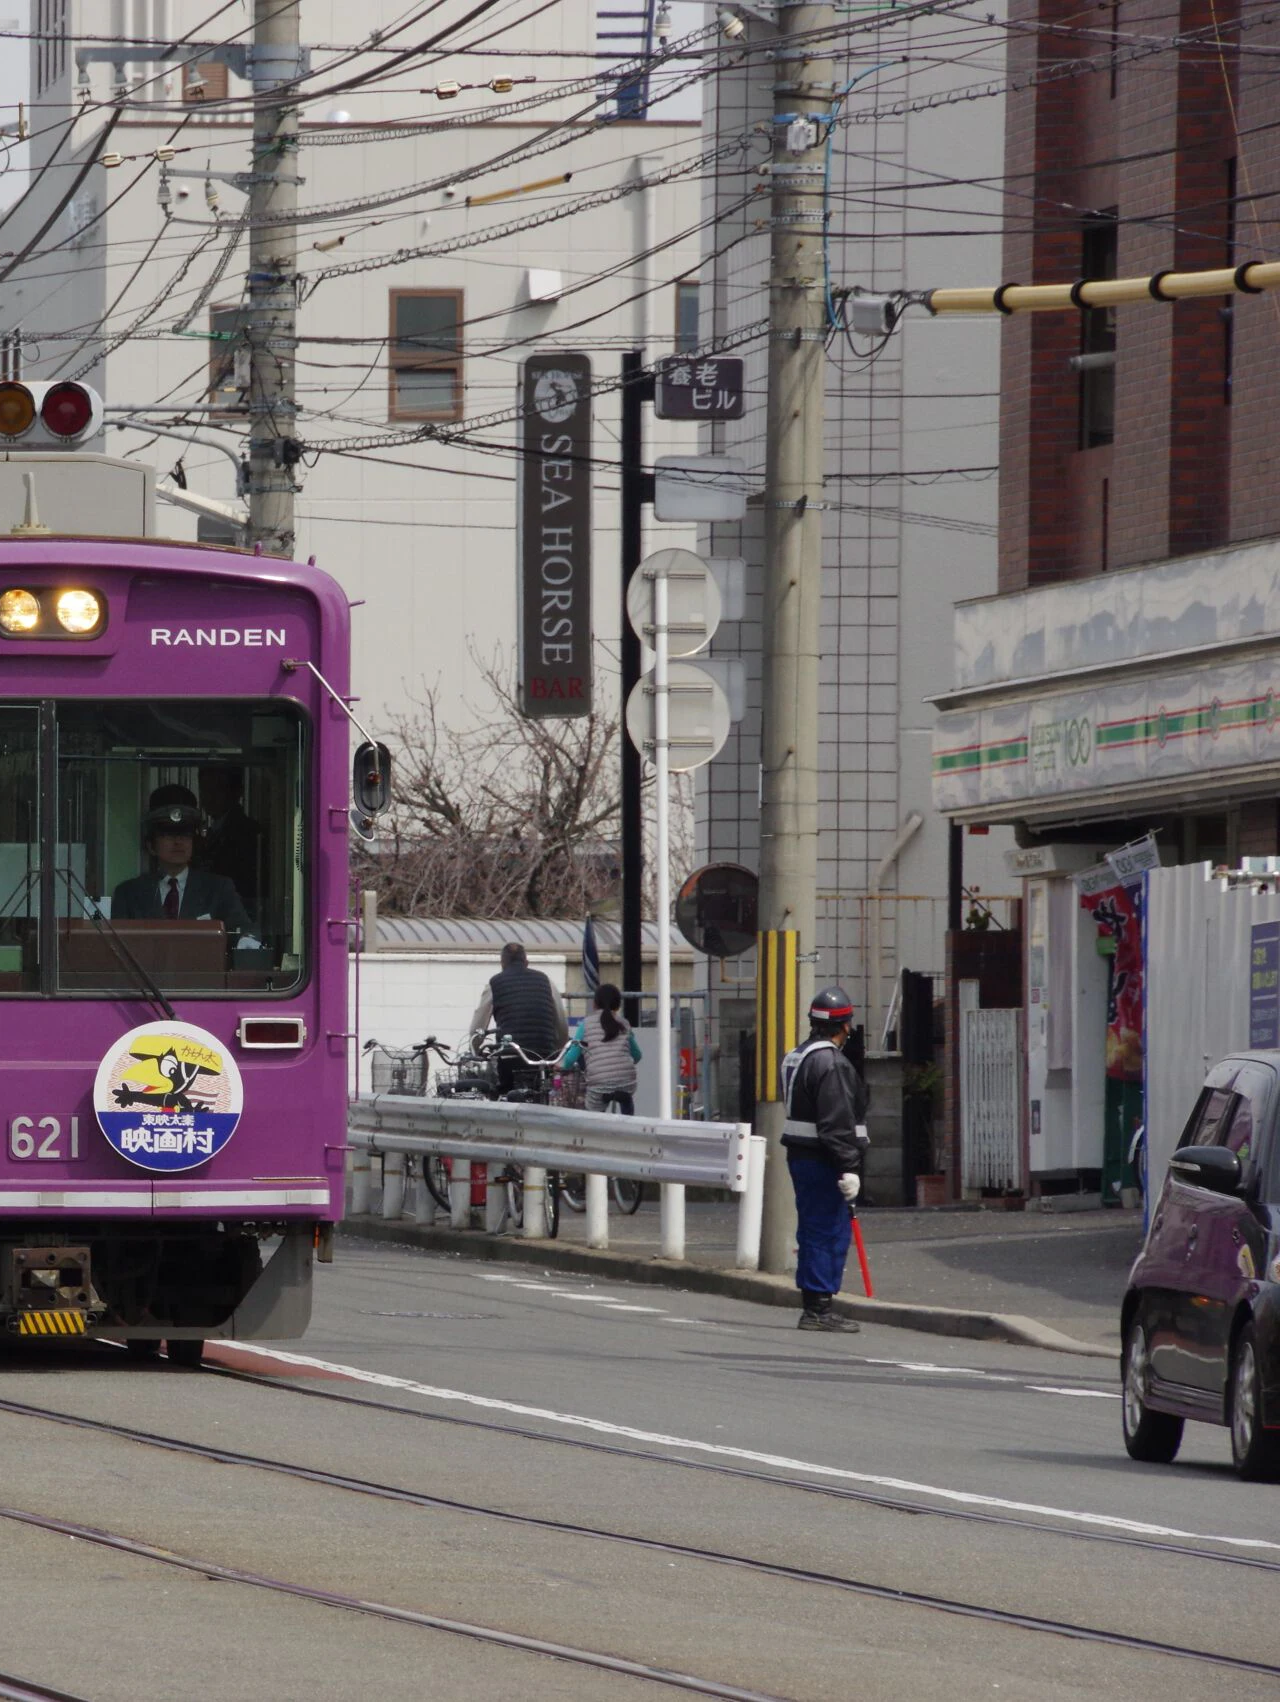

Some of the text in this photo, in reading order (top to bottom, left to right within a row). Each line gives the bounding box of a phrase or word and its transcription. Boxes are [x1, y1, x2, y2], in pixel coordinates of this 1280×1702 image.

[692, 388, 737, 410] ビル
[541, 434, 572, 513] SEA
[541, 526, 573, 665] HORSE
[151, 628, 286, 646] RANDEN
[530, 677, 585, 699] BAR
[141, 1113, 195, 1126] 東映太秦
[11, 1116, 79, 1158] 621
[121, 1127, 215, 1154] 映画村
